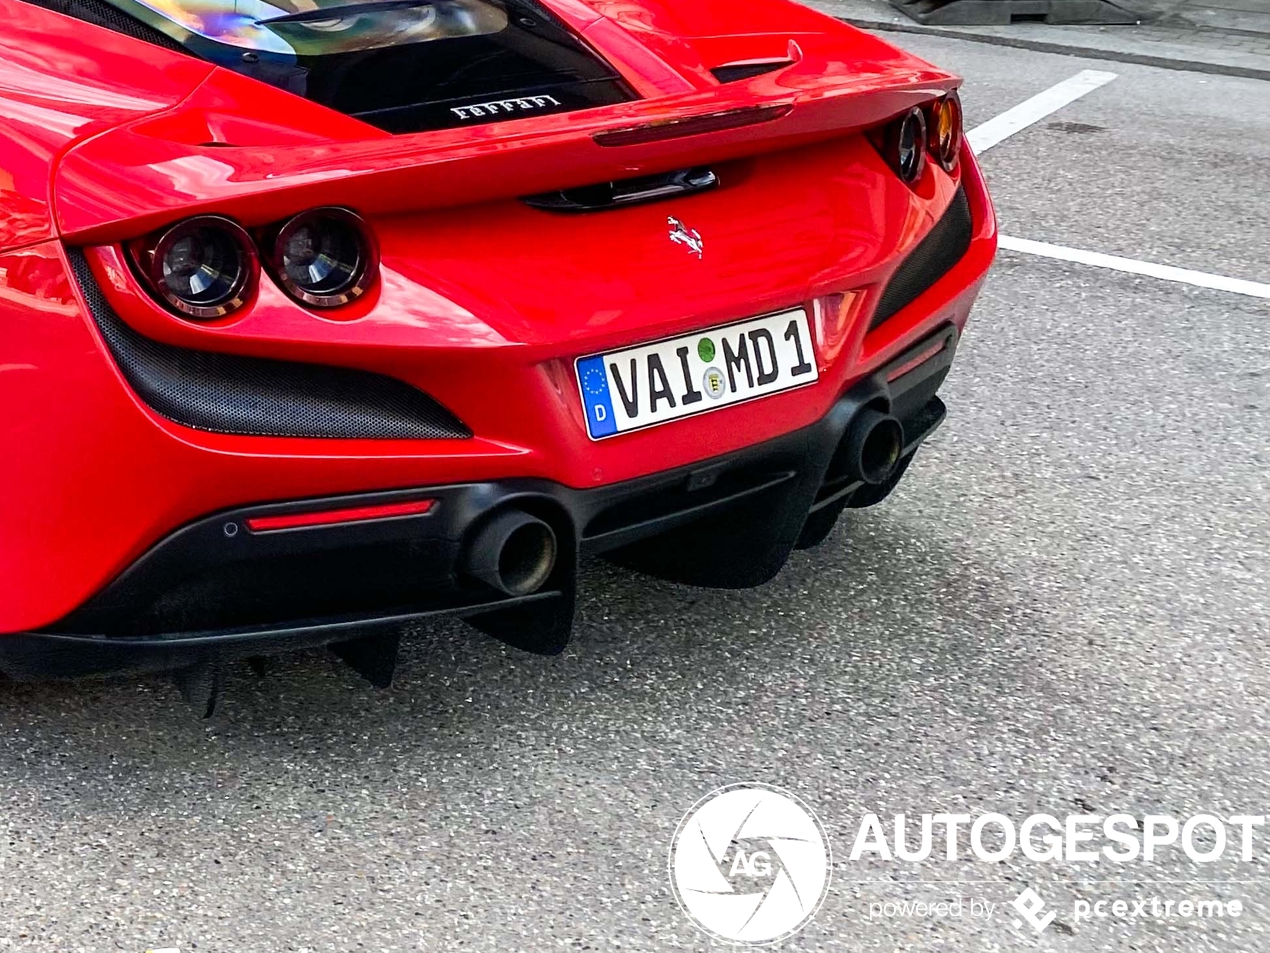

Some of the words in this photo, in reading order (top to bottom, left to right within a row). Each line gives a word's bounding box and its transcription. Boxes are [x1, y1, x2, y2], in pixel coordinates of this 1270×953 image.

[450, 94, 561, 120] Ferrari
[609, 346, 702, 419] VAI
[594, 404, 607, 422] D
